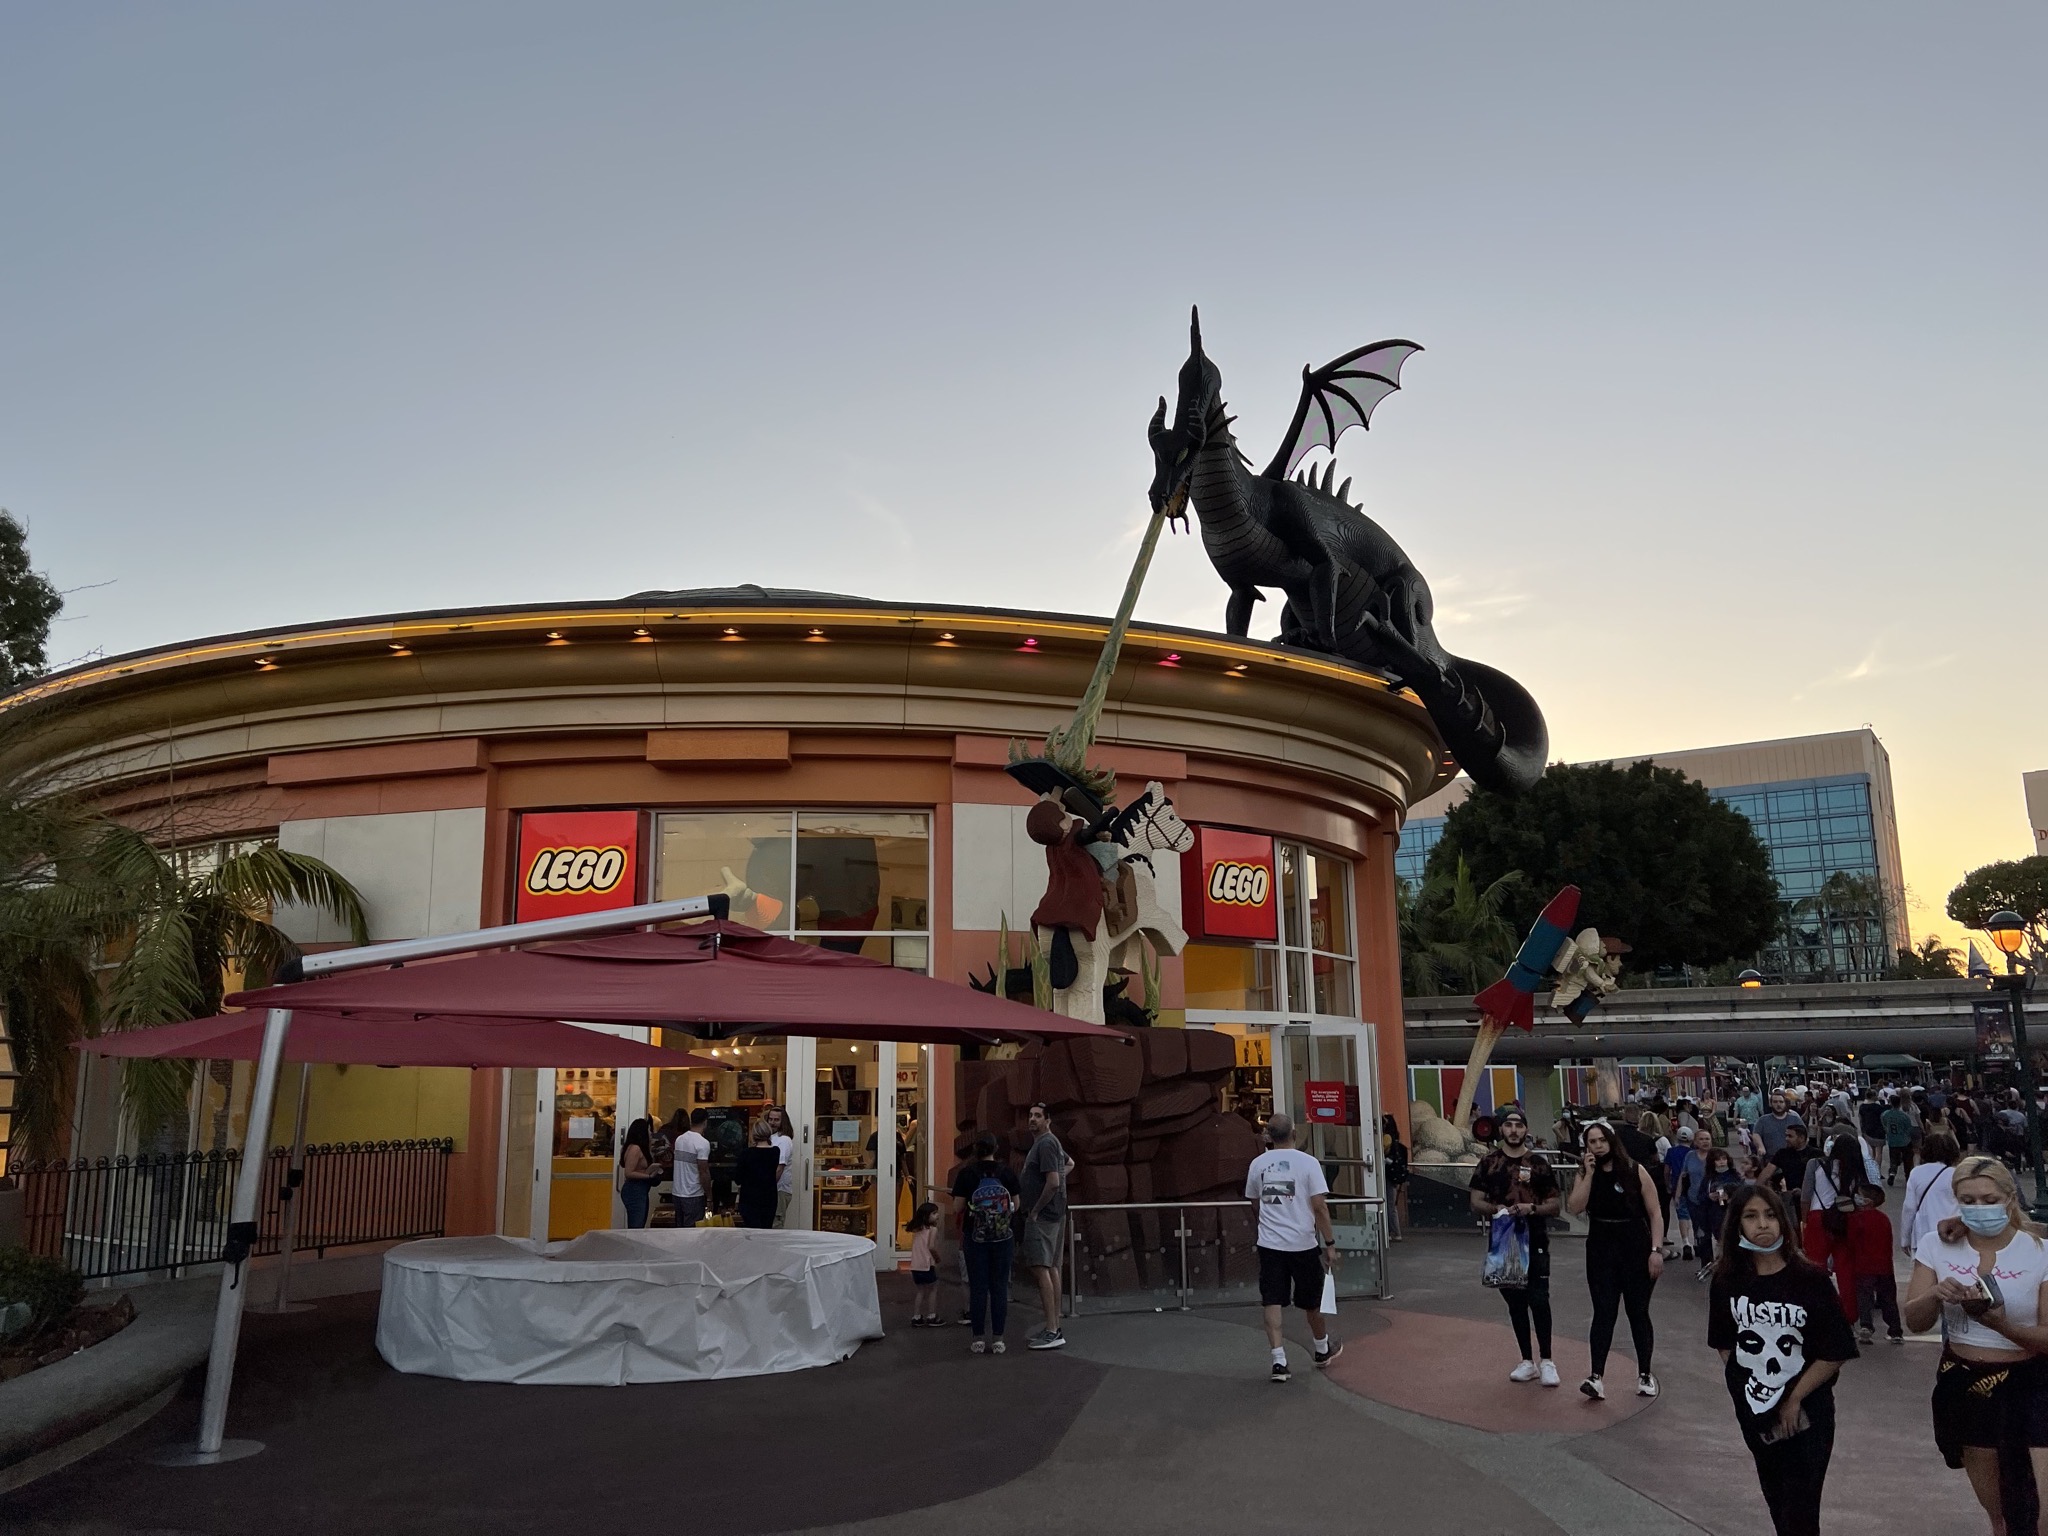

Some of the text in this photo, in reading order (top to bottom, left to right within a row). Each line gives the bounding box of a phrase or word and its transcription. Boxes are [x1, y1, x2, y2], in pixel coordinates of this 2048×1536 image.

[526, 845, 627, 895] LEGO
[1208, 860, 1270, 907] LEGO
[1311, 918, 1326, 948] EGO
[1730, 1295, 1808, 1328] MISFITS
